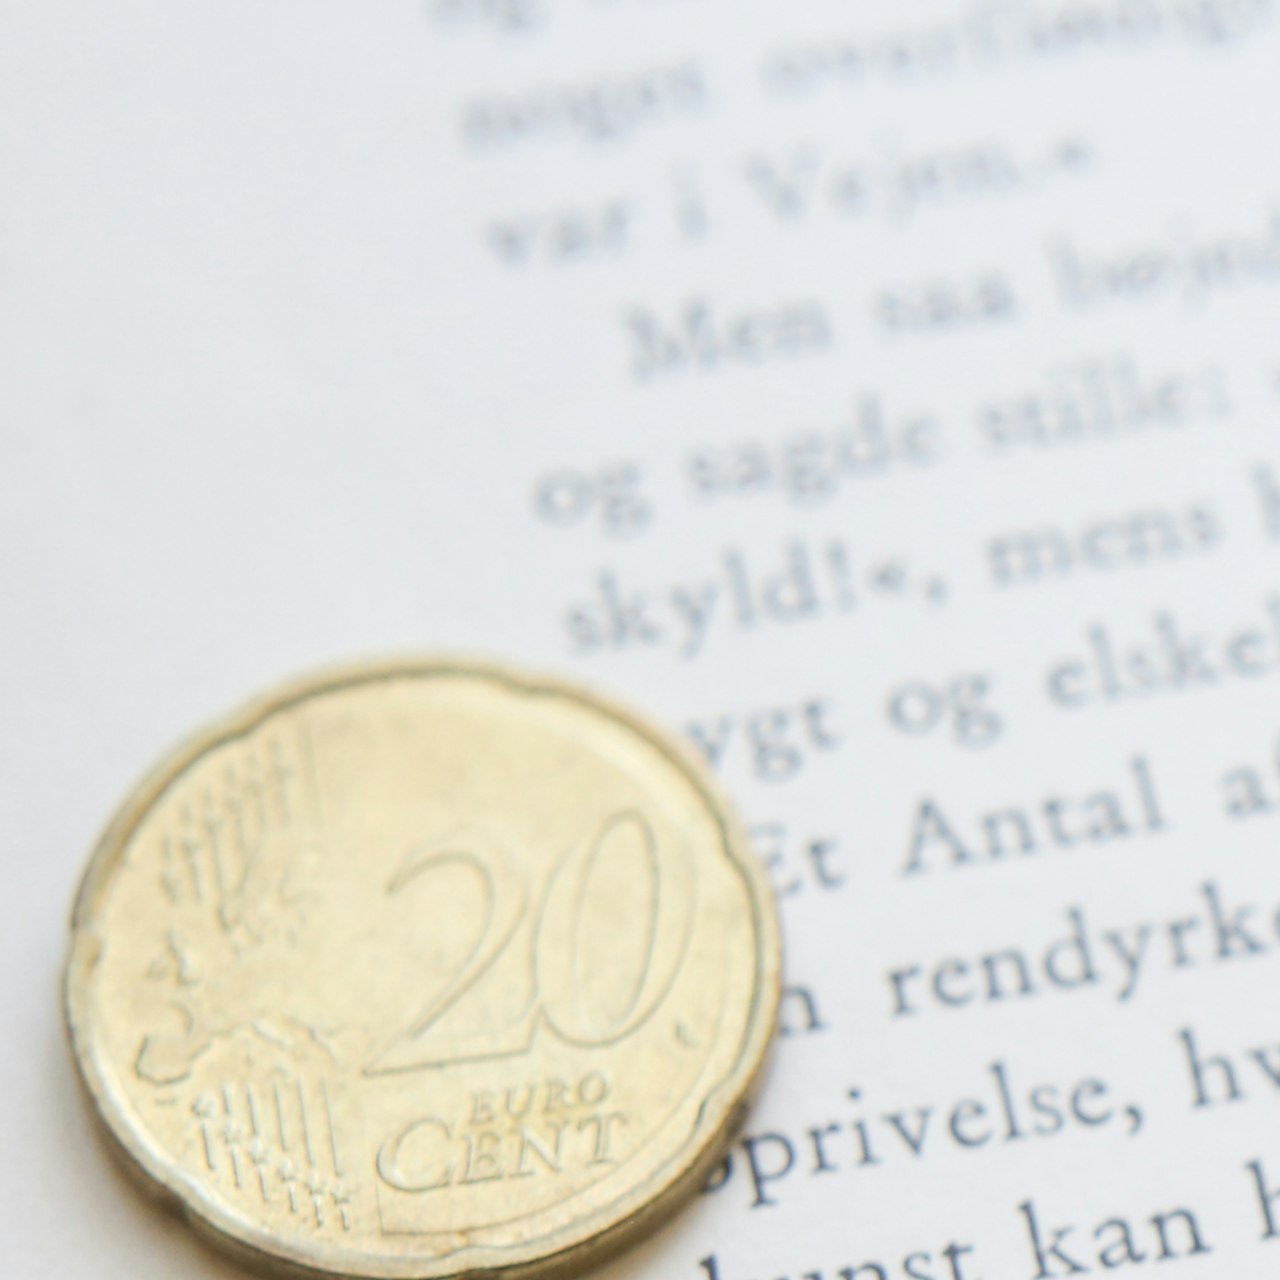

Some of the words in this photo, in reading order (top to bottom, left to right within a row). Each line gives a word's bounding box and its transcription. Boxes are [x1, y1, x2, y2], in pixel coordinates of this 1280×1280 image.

[623, 296, 833, 384] Men
[530, 461, 653, 538] og
[983, 490, 1225, 594] mens
[884, 672, 1004, 746] og
[902, 754, 1166, 877] Antal
[361, 808, 699, 1079] 20
[469, 1070, 614, 1121] EURO
[377, 1110, 632, 1195] CENT
